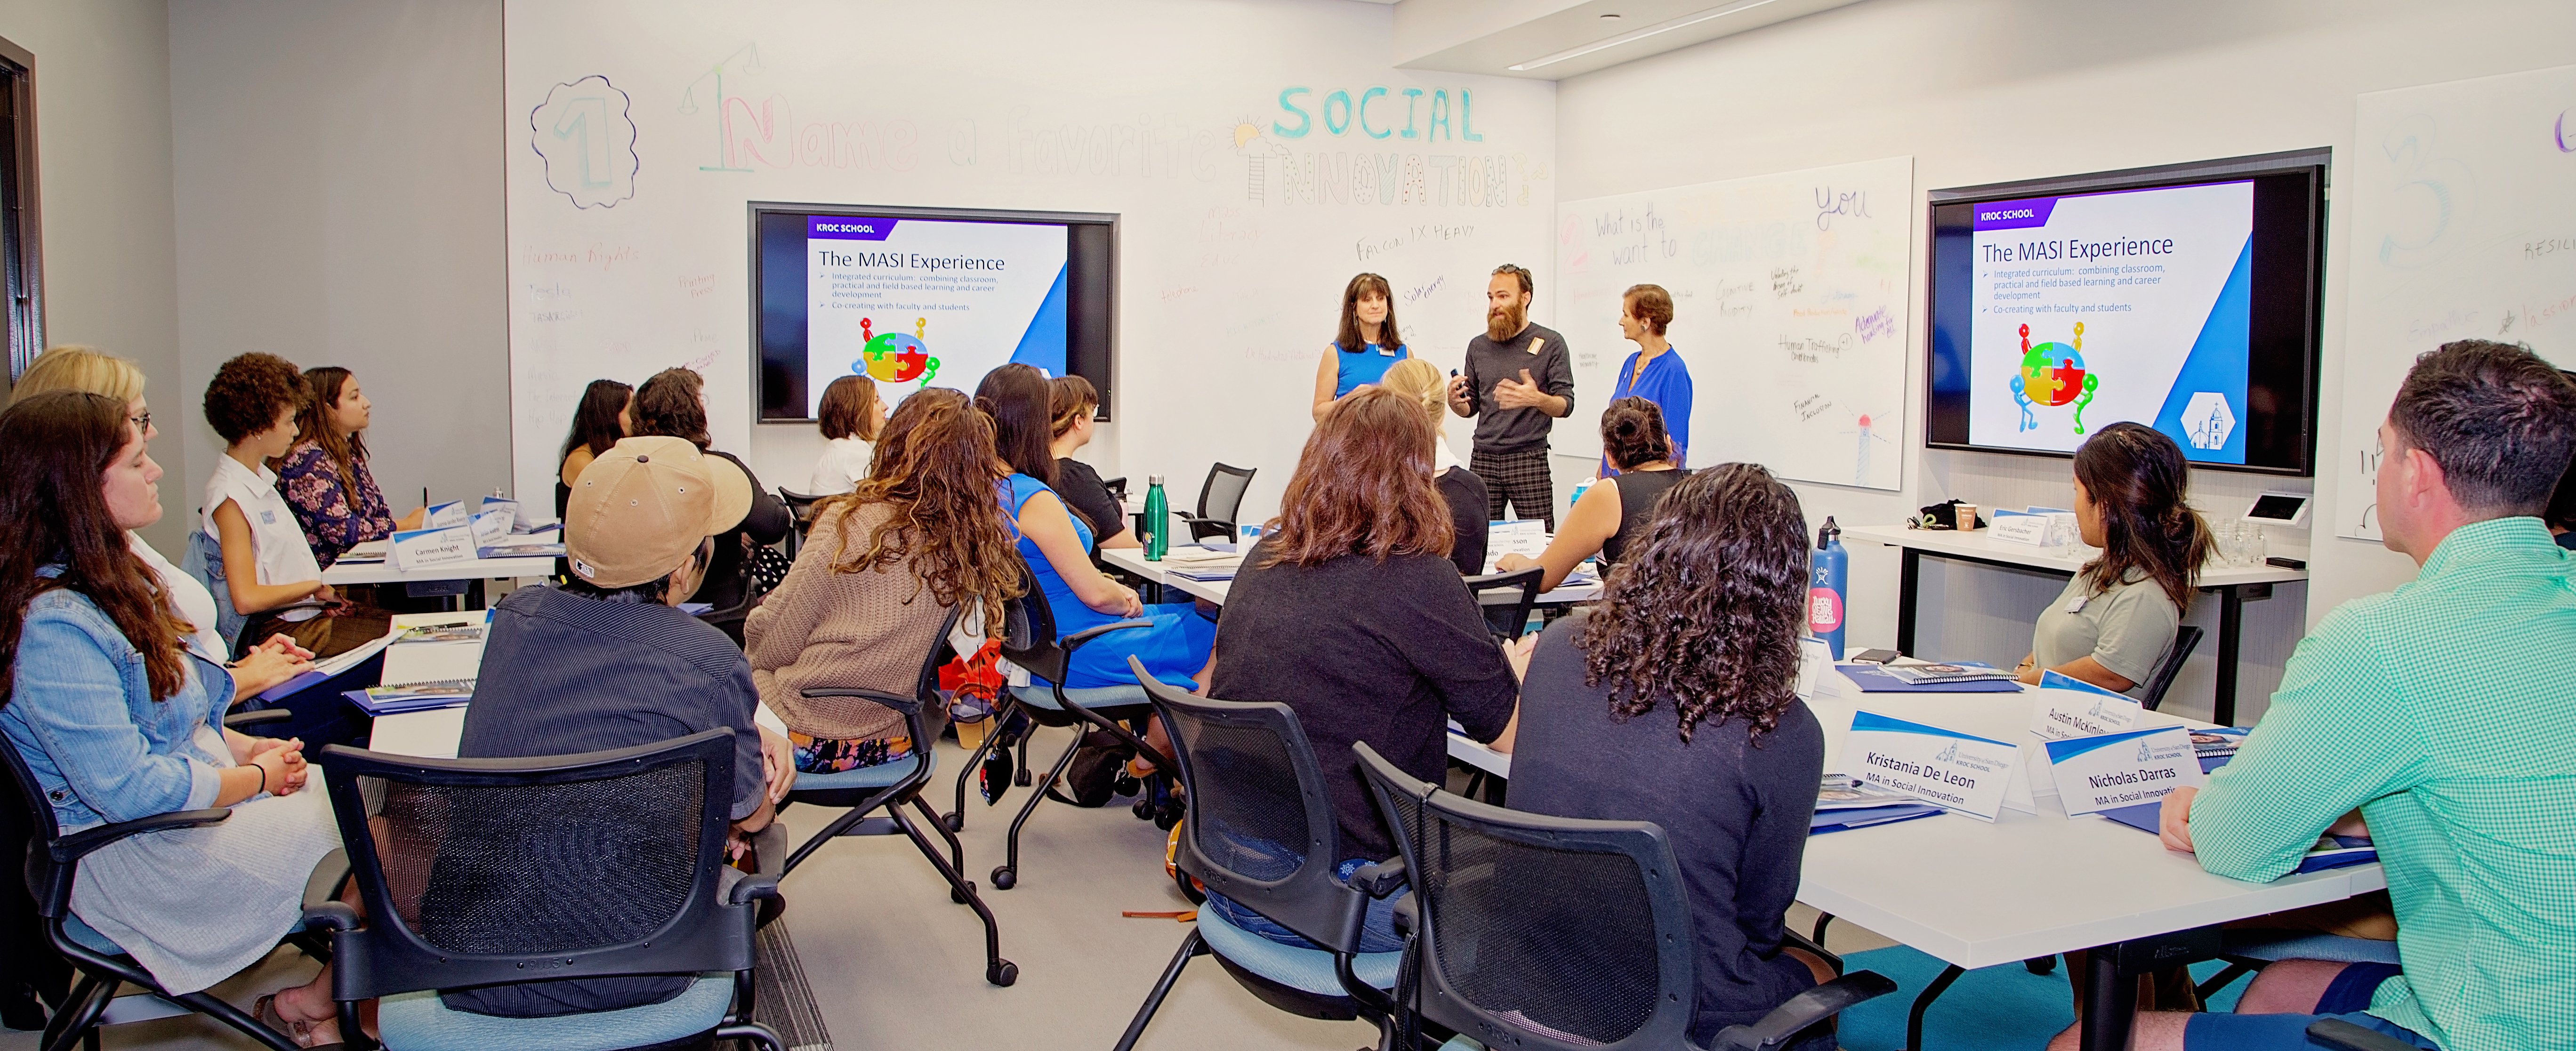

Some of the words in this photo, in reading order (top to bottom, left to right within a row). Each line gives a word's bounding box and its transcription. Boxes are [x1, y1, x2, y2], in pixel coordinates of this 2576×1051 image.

[1272, 86, 1485, 144] SOCIAL
[720, 93, 919, 171] Name
[1249, 152, 1507, 208] INNOVATION
[1596, 209, 1624, 237] What
[1631, 207, 1642, 232] is
[1646, 202, 1665, 231] the
[1981, 211, 2001, 221] KROC
[2003, 209, 2034, 220] SCHOOL
[816, 224, 839, 233] KROC
[840, 224, 874, 233] SCHOOL
[1356, 236, 1404, 261] FALCON
[1434, 225, 1474, 241] HEAVY
[1613, 233, 1649, 265] want
[1661, 231, 1677, 258] to
[1983, 244, 2012, 263] The
[2019, 241, 2062, 261] MASI
[2069, 236, 2174, 262] Experience
[522, 244, 577, 265] Human
[588, 242, 639, 271] Rights
[819, 251, 852, 267] The
[859, 252, 904, 268] MASI
[911, 253, 1005, 272] Experience
[832, 273, 871, 282] Integrated
[919, 274, 958, 284] combining
[960, 276, 998, 285] classroom,
[1994, 269, 2030, 279] Integrated
[2032, 267, 2075, 277] curriculum:
[2078, 265, 2119, 276] combining
[2121, 264, 2165, 273] classroom,
[832, 282, 865, 291] practical
[882, 282, 899, 290] field
[901, 283, 923, 291] based
[925, 283, 954, 293] learning
[956, 284, 971, 292] and
[1424, 274, 1446, 299] energy
[1994, 280, 2023, 290] practical
[2026, 280, 2039, 288] and
[2041, 279, 2057, 288] field
[2059, 278, 2081, 287] based
[2084, 276, 2115, 288] learning
[2117, 276, 2133, 285] and
[2134, 276, 2161, 285] career
[832, 291, 882, 300] development
[1404, 283, 1425, 306] Solar
[1994, 291, 2040, 301] development
[832, 302, 875, 311] Co-creating
[896, 303, 921, 312] faculty
[938, 304, 970, 312] students
[1993, 304, 2034, 315] Co-creating
[2036, 304, 2052, 313] with
[2054, 303, 2079, 314] faculty
[2081, 303, 2095, 312] and
[2097, 303, 2132, 312] students
[1778, 334, 1804, 351] Human
[1805, 338, 1840, 359] Trafficking
[1801, 401, 1832, 422] INCLUSION
[2008, 526, 2031, 535] Gersbacher
[415, 546, 439, 556] Carmen
[440, 545, 459, 554] Knight
[2049, 708, 2071, 725] Austin
[2046, 725, 2054, 734] MA
[2055, 729, 2060, 738] in
[1958, 752, 1981, 762] University
[1994, 761, 2009, 769] Diego
[1970, 763, 1990, 772] SCHOOL
[1867, 752, 1919, 776] Kristania
[1923, 765, 1940, 780] De
[1944, 770, 1975, 789] Leon
[2089, 771, 2138, 789] Nicholas
[2139, 768, 2176, 781] Darras
[1866, 772, 1880, 783] MA
[1882, 776, 1890, 786] in
[1892, 778, 1916, 792] Social
[1917, 785, 1964, 804] Innovation
[2095, 796, 2110, 806] MA
[2110, 795, 2119, 803] in
[2119, 791, 2142, 802] Social
